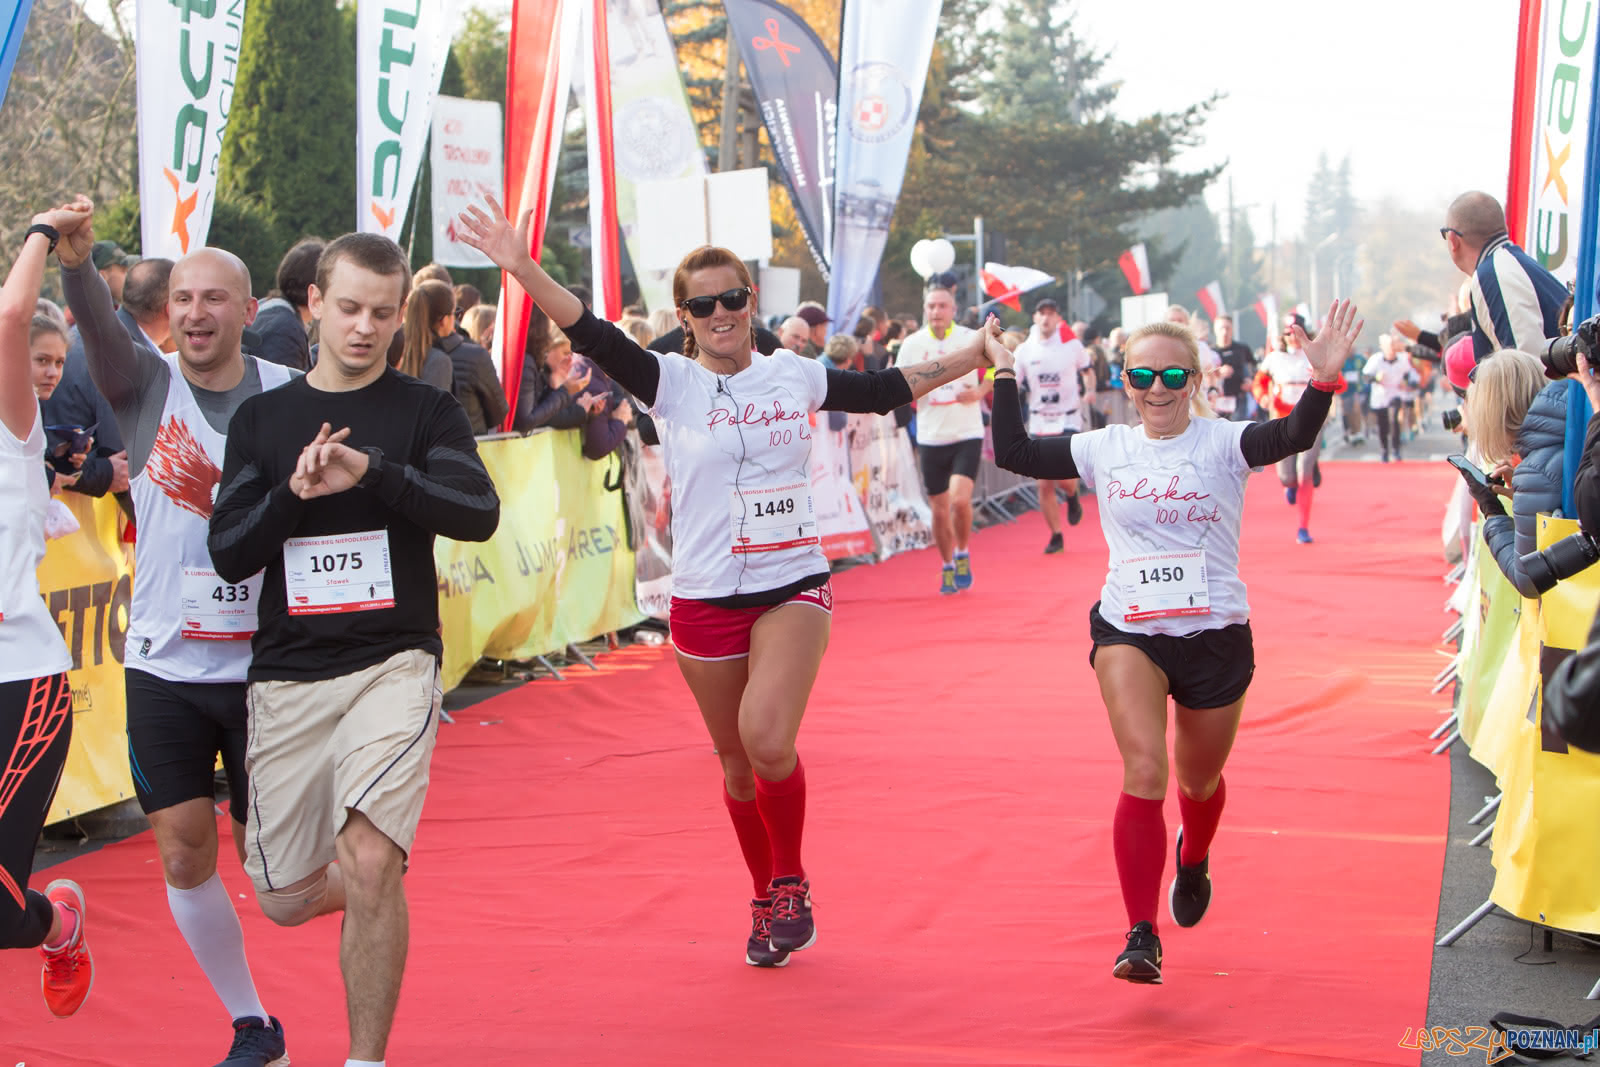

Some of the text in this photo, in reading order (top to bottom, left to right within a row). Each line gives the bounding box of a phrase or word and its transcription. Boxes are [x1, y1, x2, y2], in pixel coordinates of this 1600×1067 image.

[706, 400, 806, 431] Polska
[769, 429, 792, 447] 100
[1106, 475, 1210, 503] Polska
[754, 498, 794, 517] 1449
[1155, 504, 1222, 524] 100 lat
[310, 552, 363, 573] 1075
[1139, 566, 1184, 585] 1450
[212, 585, 249, 602] 433
[40, 574, 131, 671] ETTO
